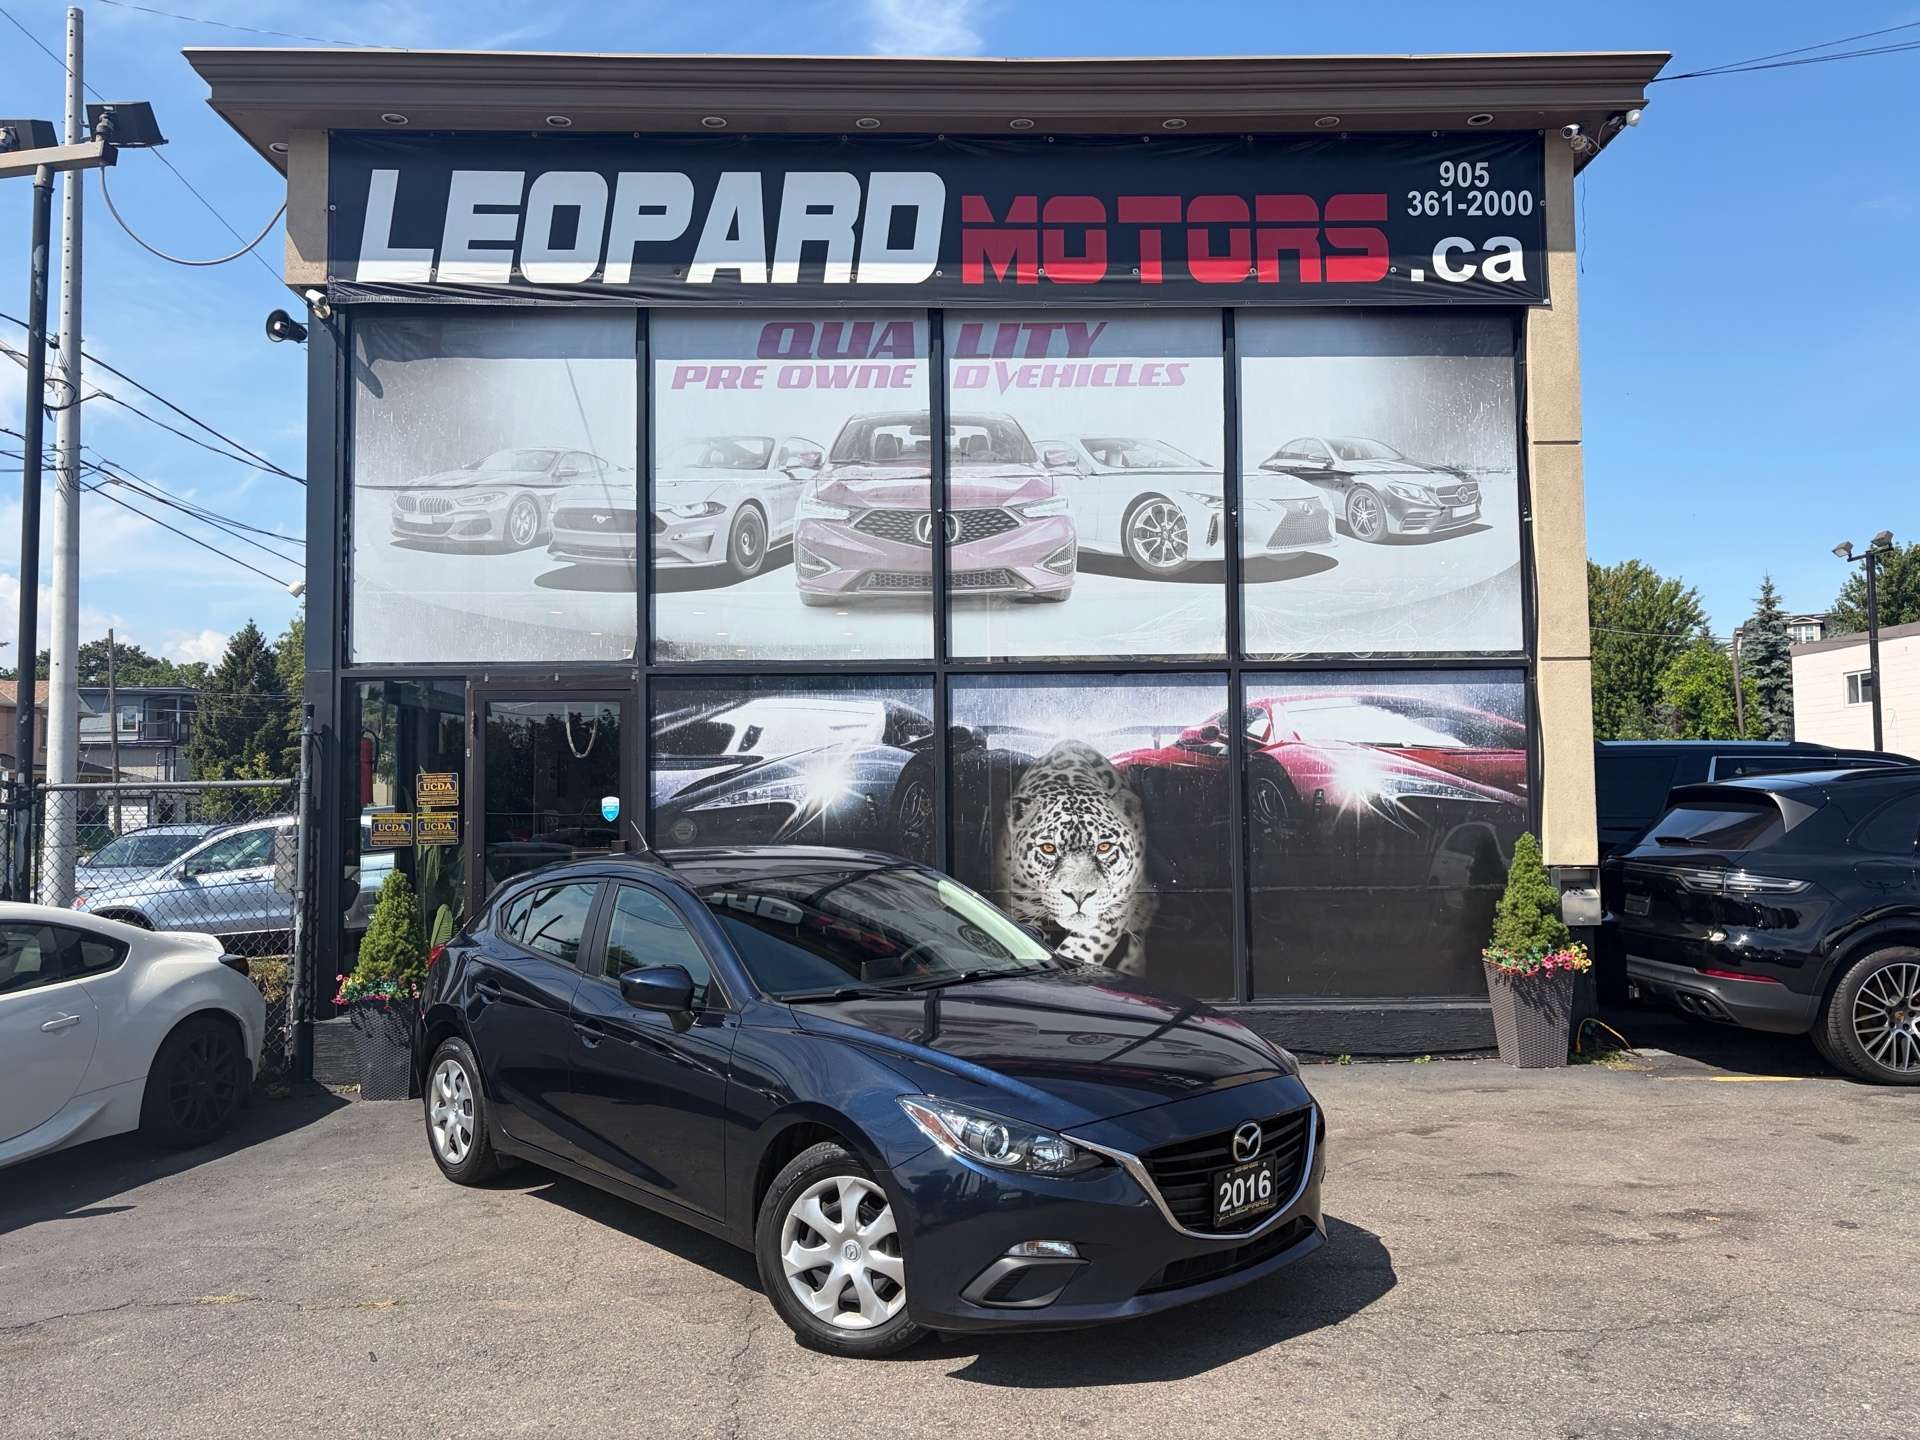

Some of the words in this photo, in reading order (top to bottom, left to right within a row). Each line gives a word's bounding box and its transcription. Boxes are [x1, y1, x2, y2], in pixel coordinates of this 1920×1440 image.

[1439, 161, 1490, 188] 905
[1406, 190, 1533, 218] 361-2000
[355, 169, 946, 285] LEOPARD
[961, 193, 1390, 285] MOTORS
[1411, 235, 1528, 284] .ca
[671, 365, 767, 389] PRE
[423, 782, 452, 791] UCDA
[378, 823, 406, 832] UCDA
[423, 822, 452, 831] UCDA
[1219, 1169, 1272, 1213] 2016
